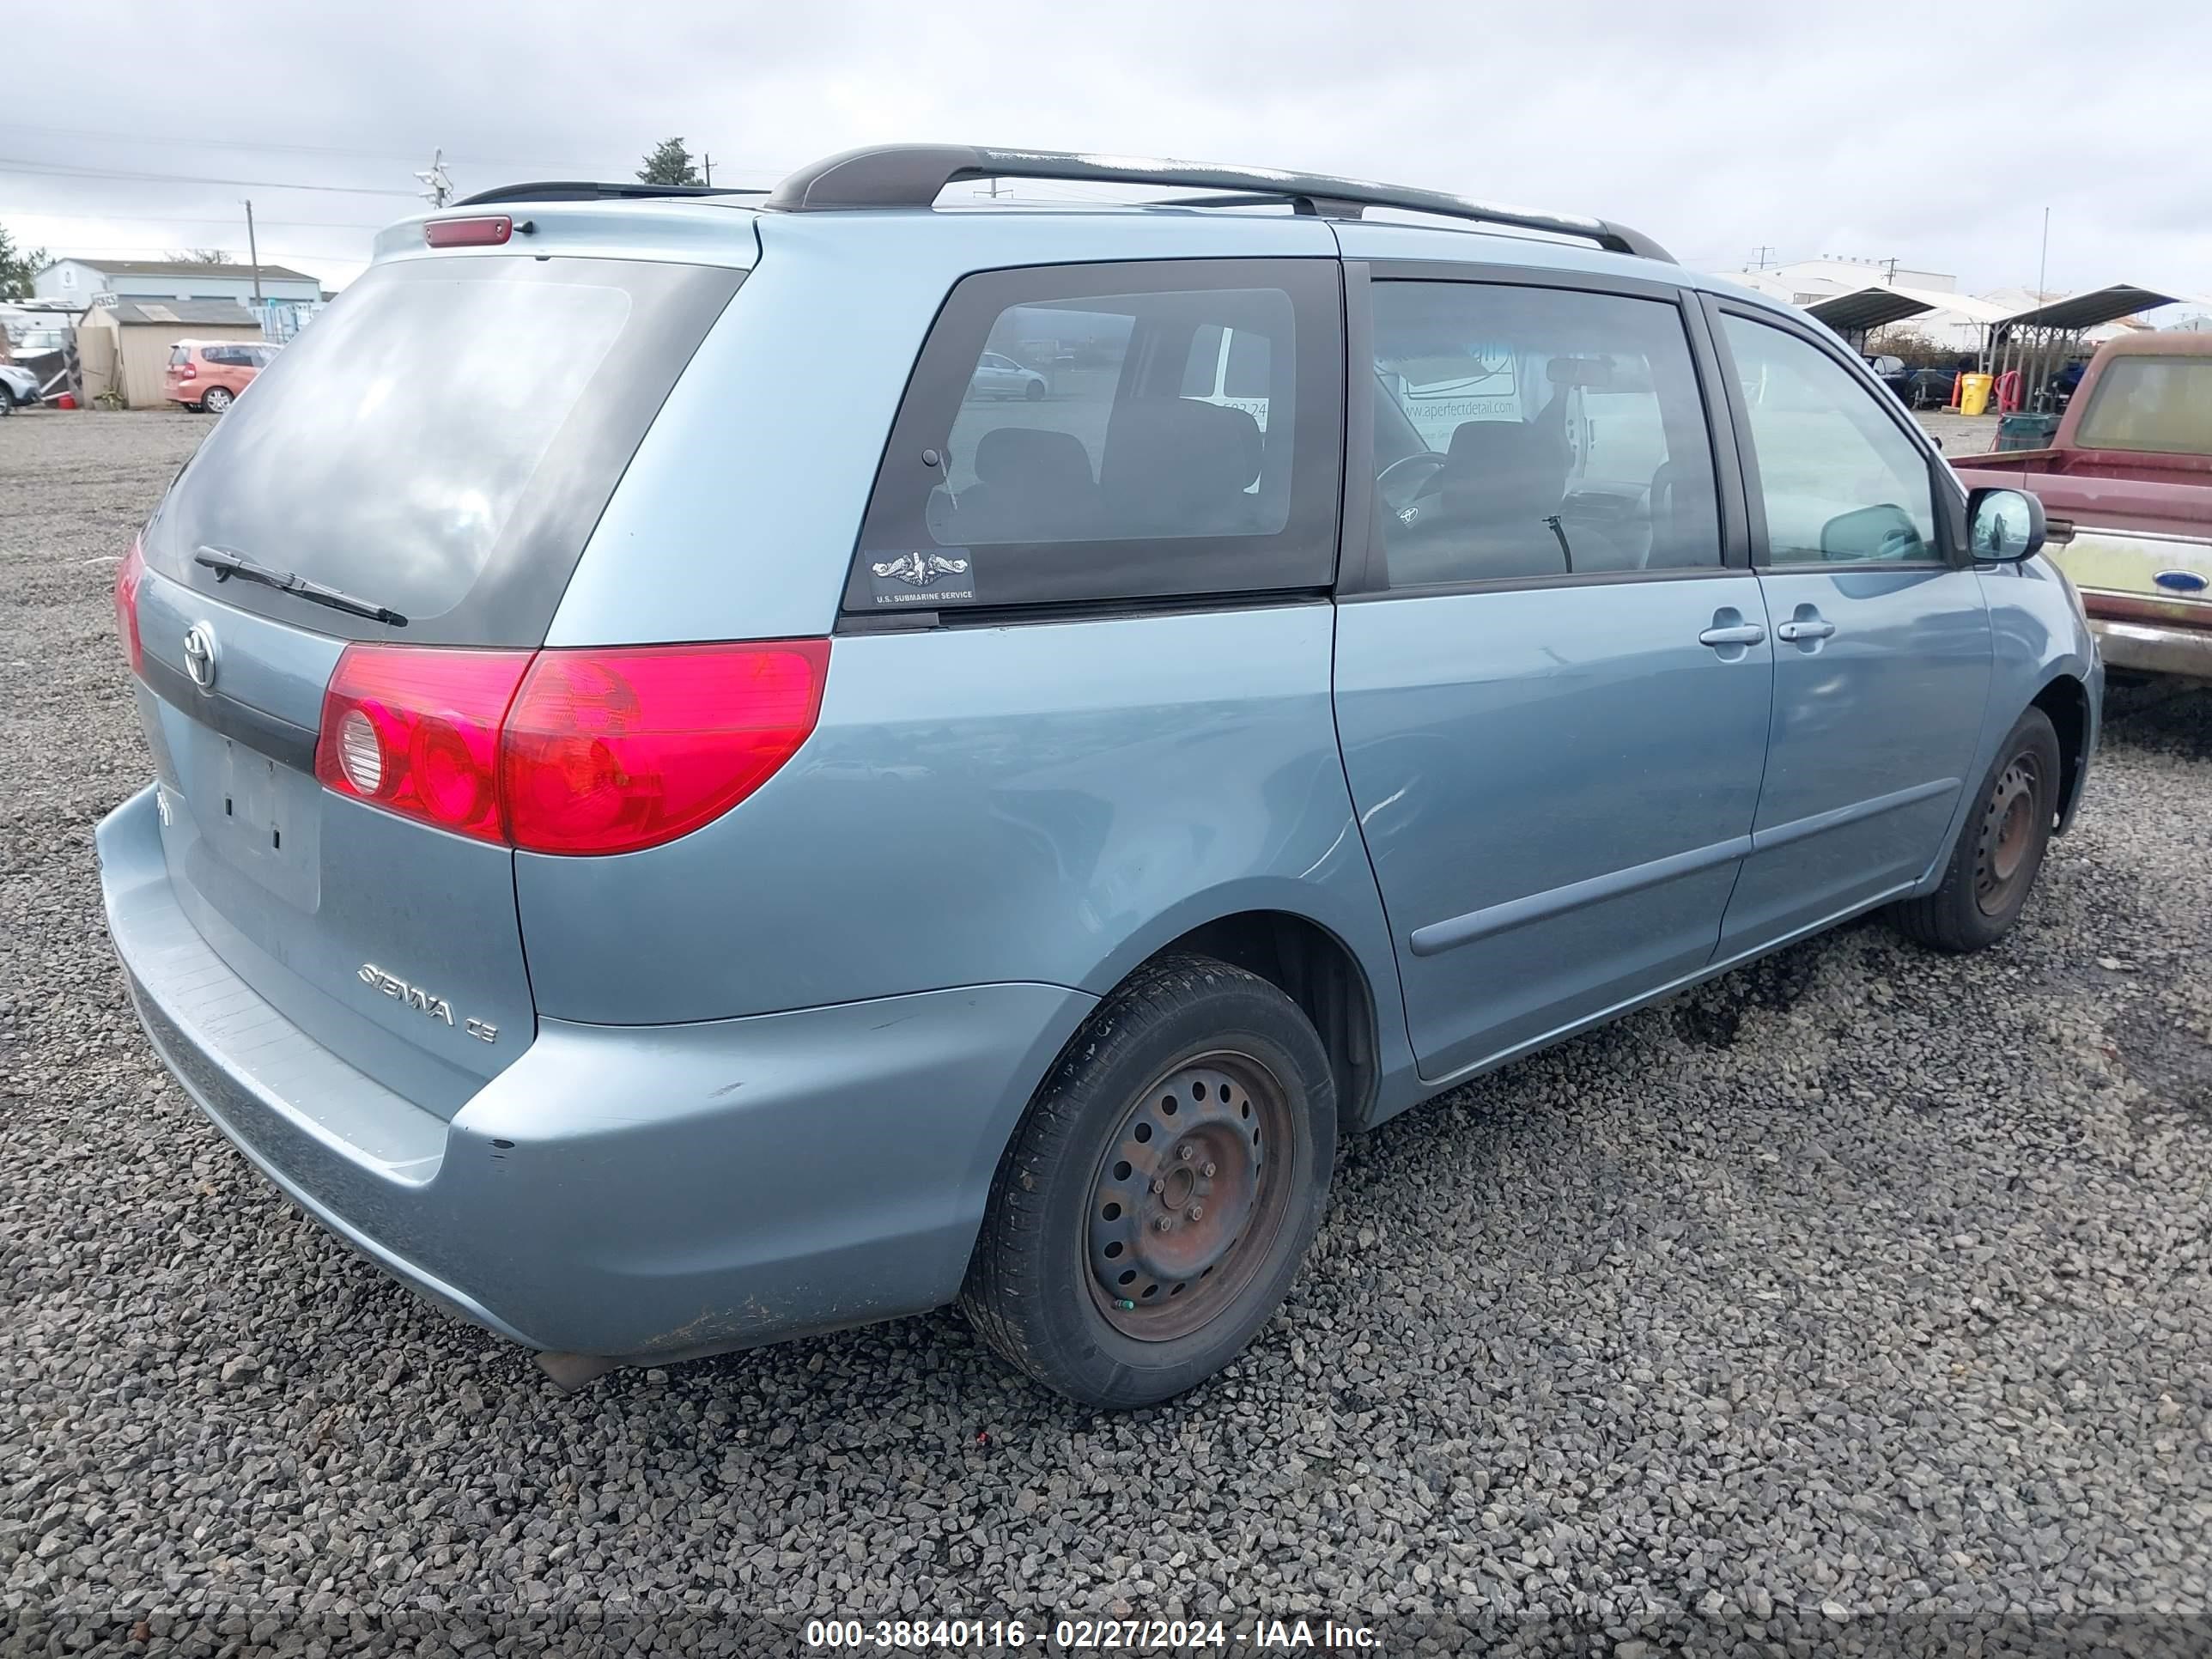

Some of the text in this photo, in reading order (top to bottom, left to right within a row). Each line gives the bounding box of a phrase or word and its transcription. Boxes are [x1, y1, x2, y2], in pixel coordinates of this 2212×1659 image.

[894, 592, 939, 603] SUBMARINE
[941, 591, 973, 599] SERVICE
[357, 963, 498, 1044] SIENNA CE
